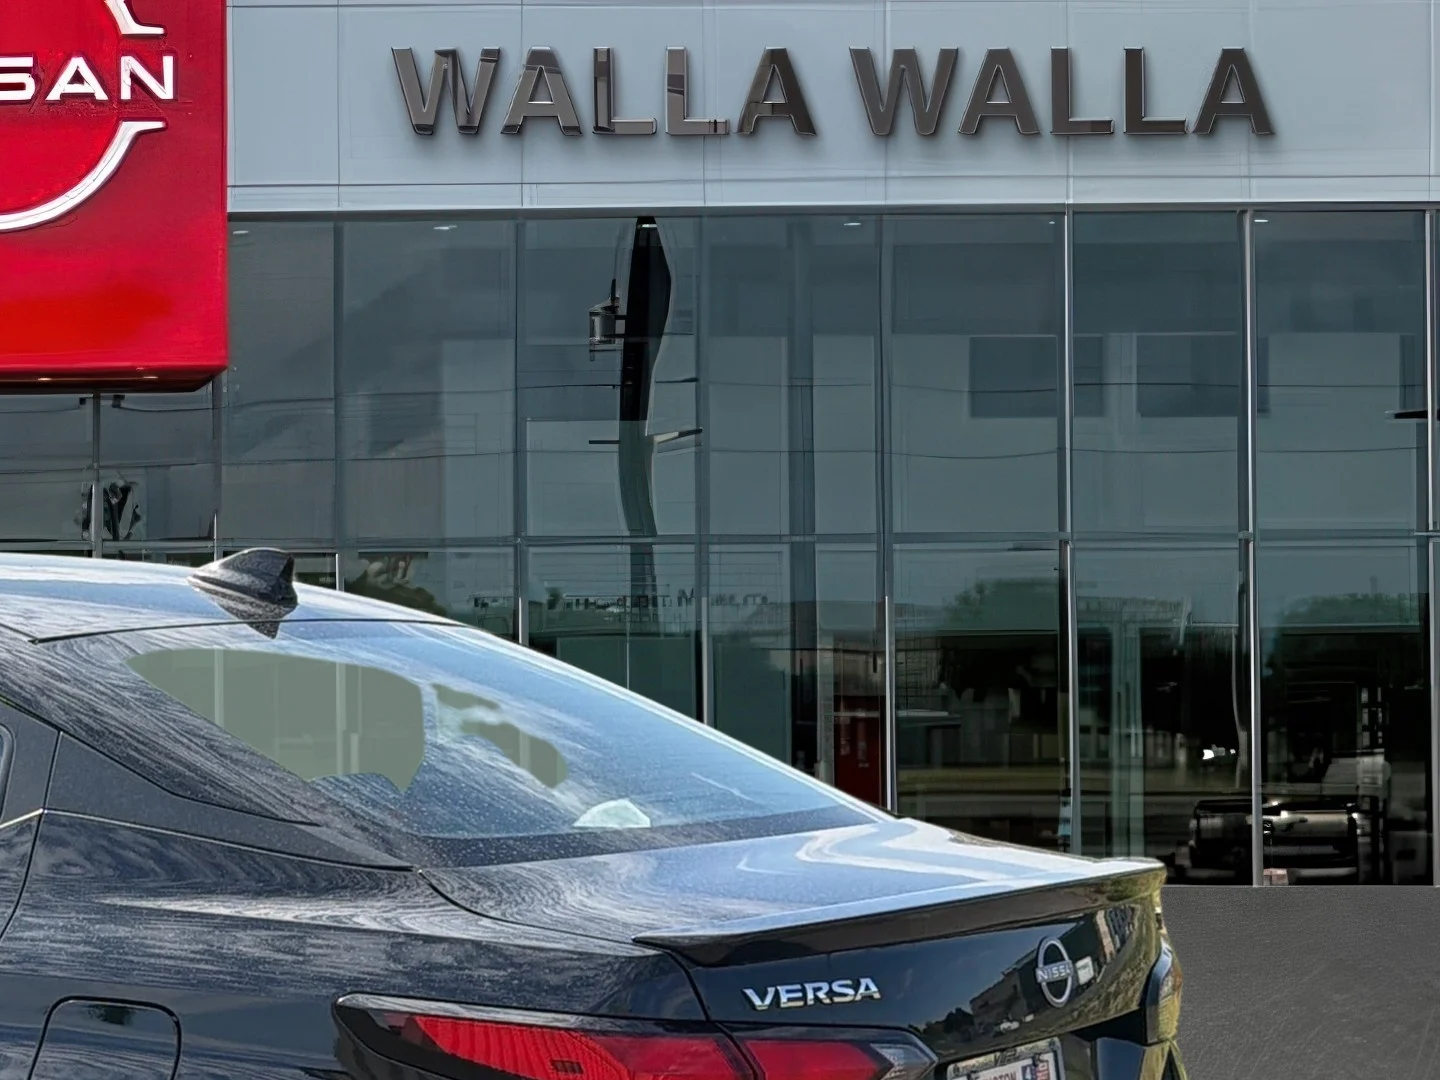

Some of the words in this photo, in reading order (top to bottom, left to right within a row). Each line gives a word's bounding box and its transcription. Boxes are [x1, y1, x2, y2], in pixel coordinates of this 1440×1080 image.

[391, 46, 818, 136] WALLA
[849, 46, 1276, 136] WALLA
[1037, 963, 1071, 982] NISS
[742, 976, 882, 1011] VERSA
